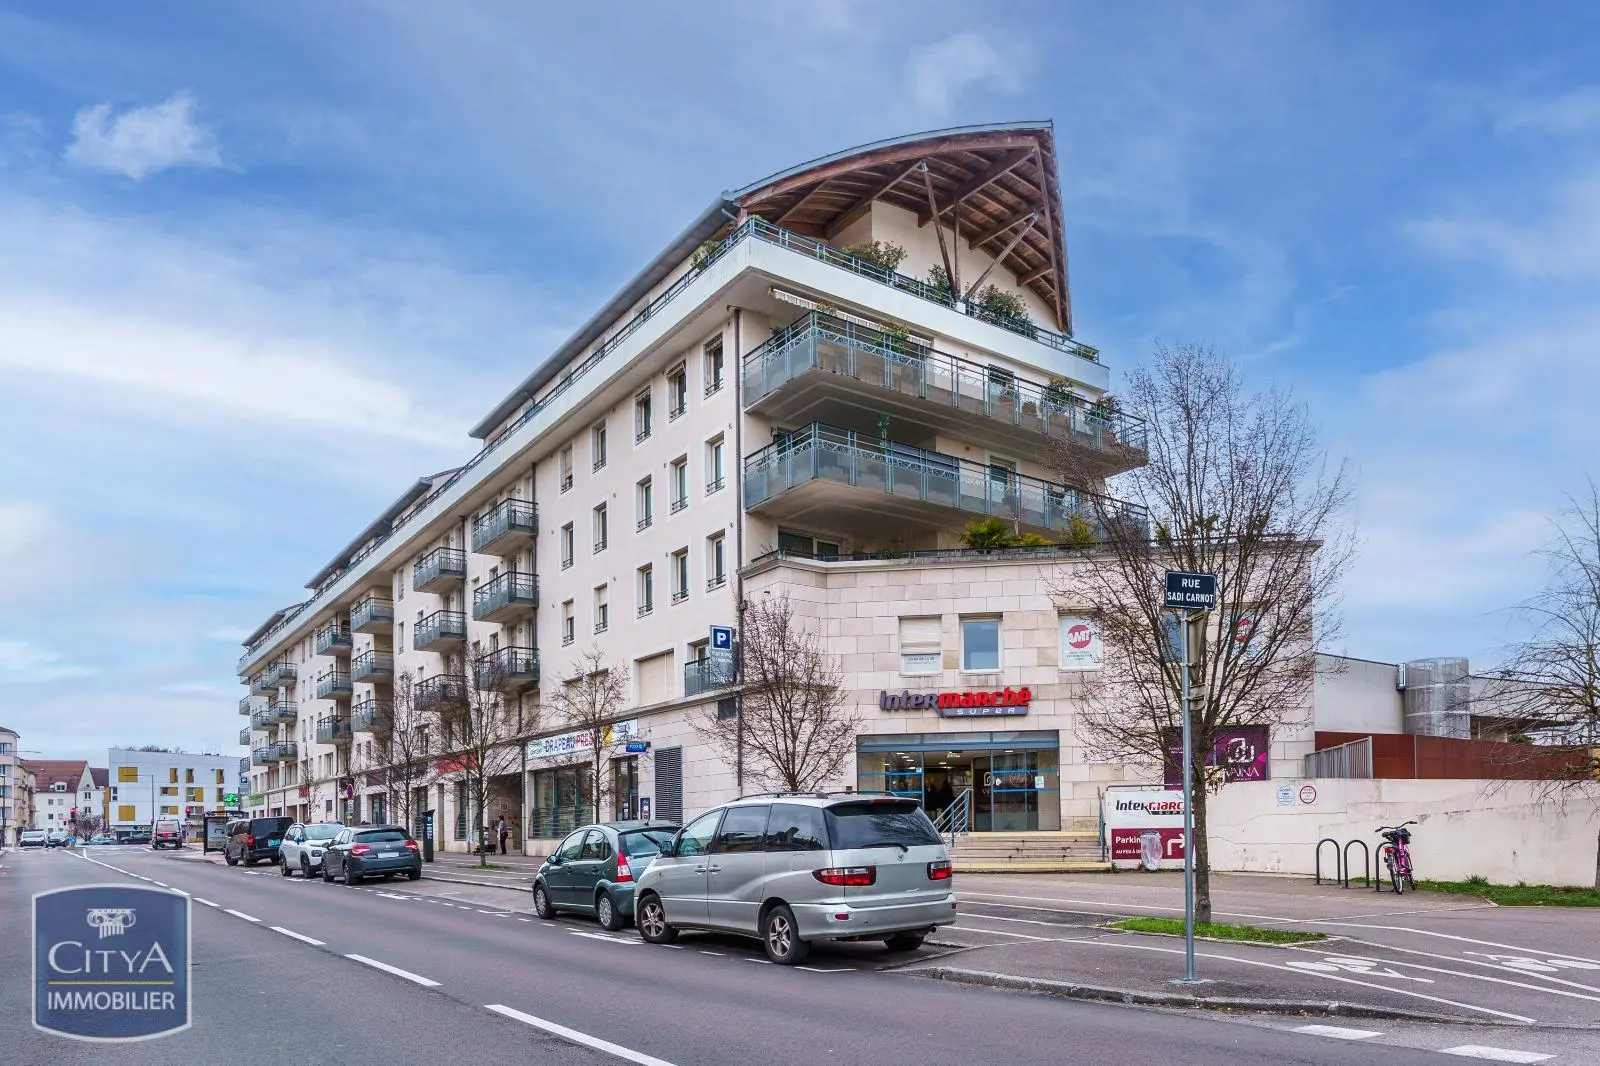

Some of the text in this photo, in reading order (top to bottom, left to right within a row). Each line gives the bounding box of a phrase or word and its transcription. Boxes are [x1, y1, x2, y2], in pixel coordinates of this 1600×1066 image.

[1181, 578, 1201, 588] RUE
[1167, 591, 1214, 603] SADI CARNOT
[716, 631, 727, 645] P
[880, 686, 1032, 712] Intermarché
[956, 707, 1016, 715] SUPER
[1115, 800, 1184, 811] Intermarc
[1115, 836, 1141, 844] Parkin
